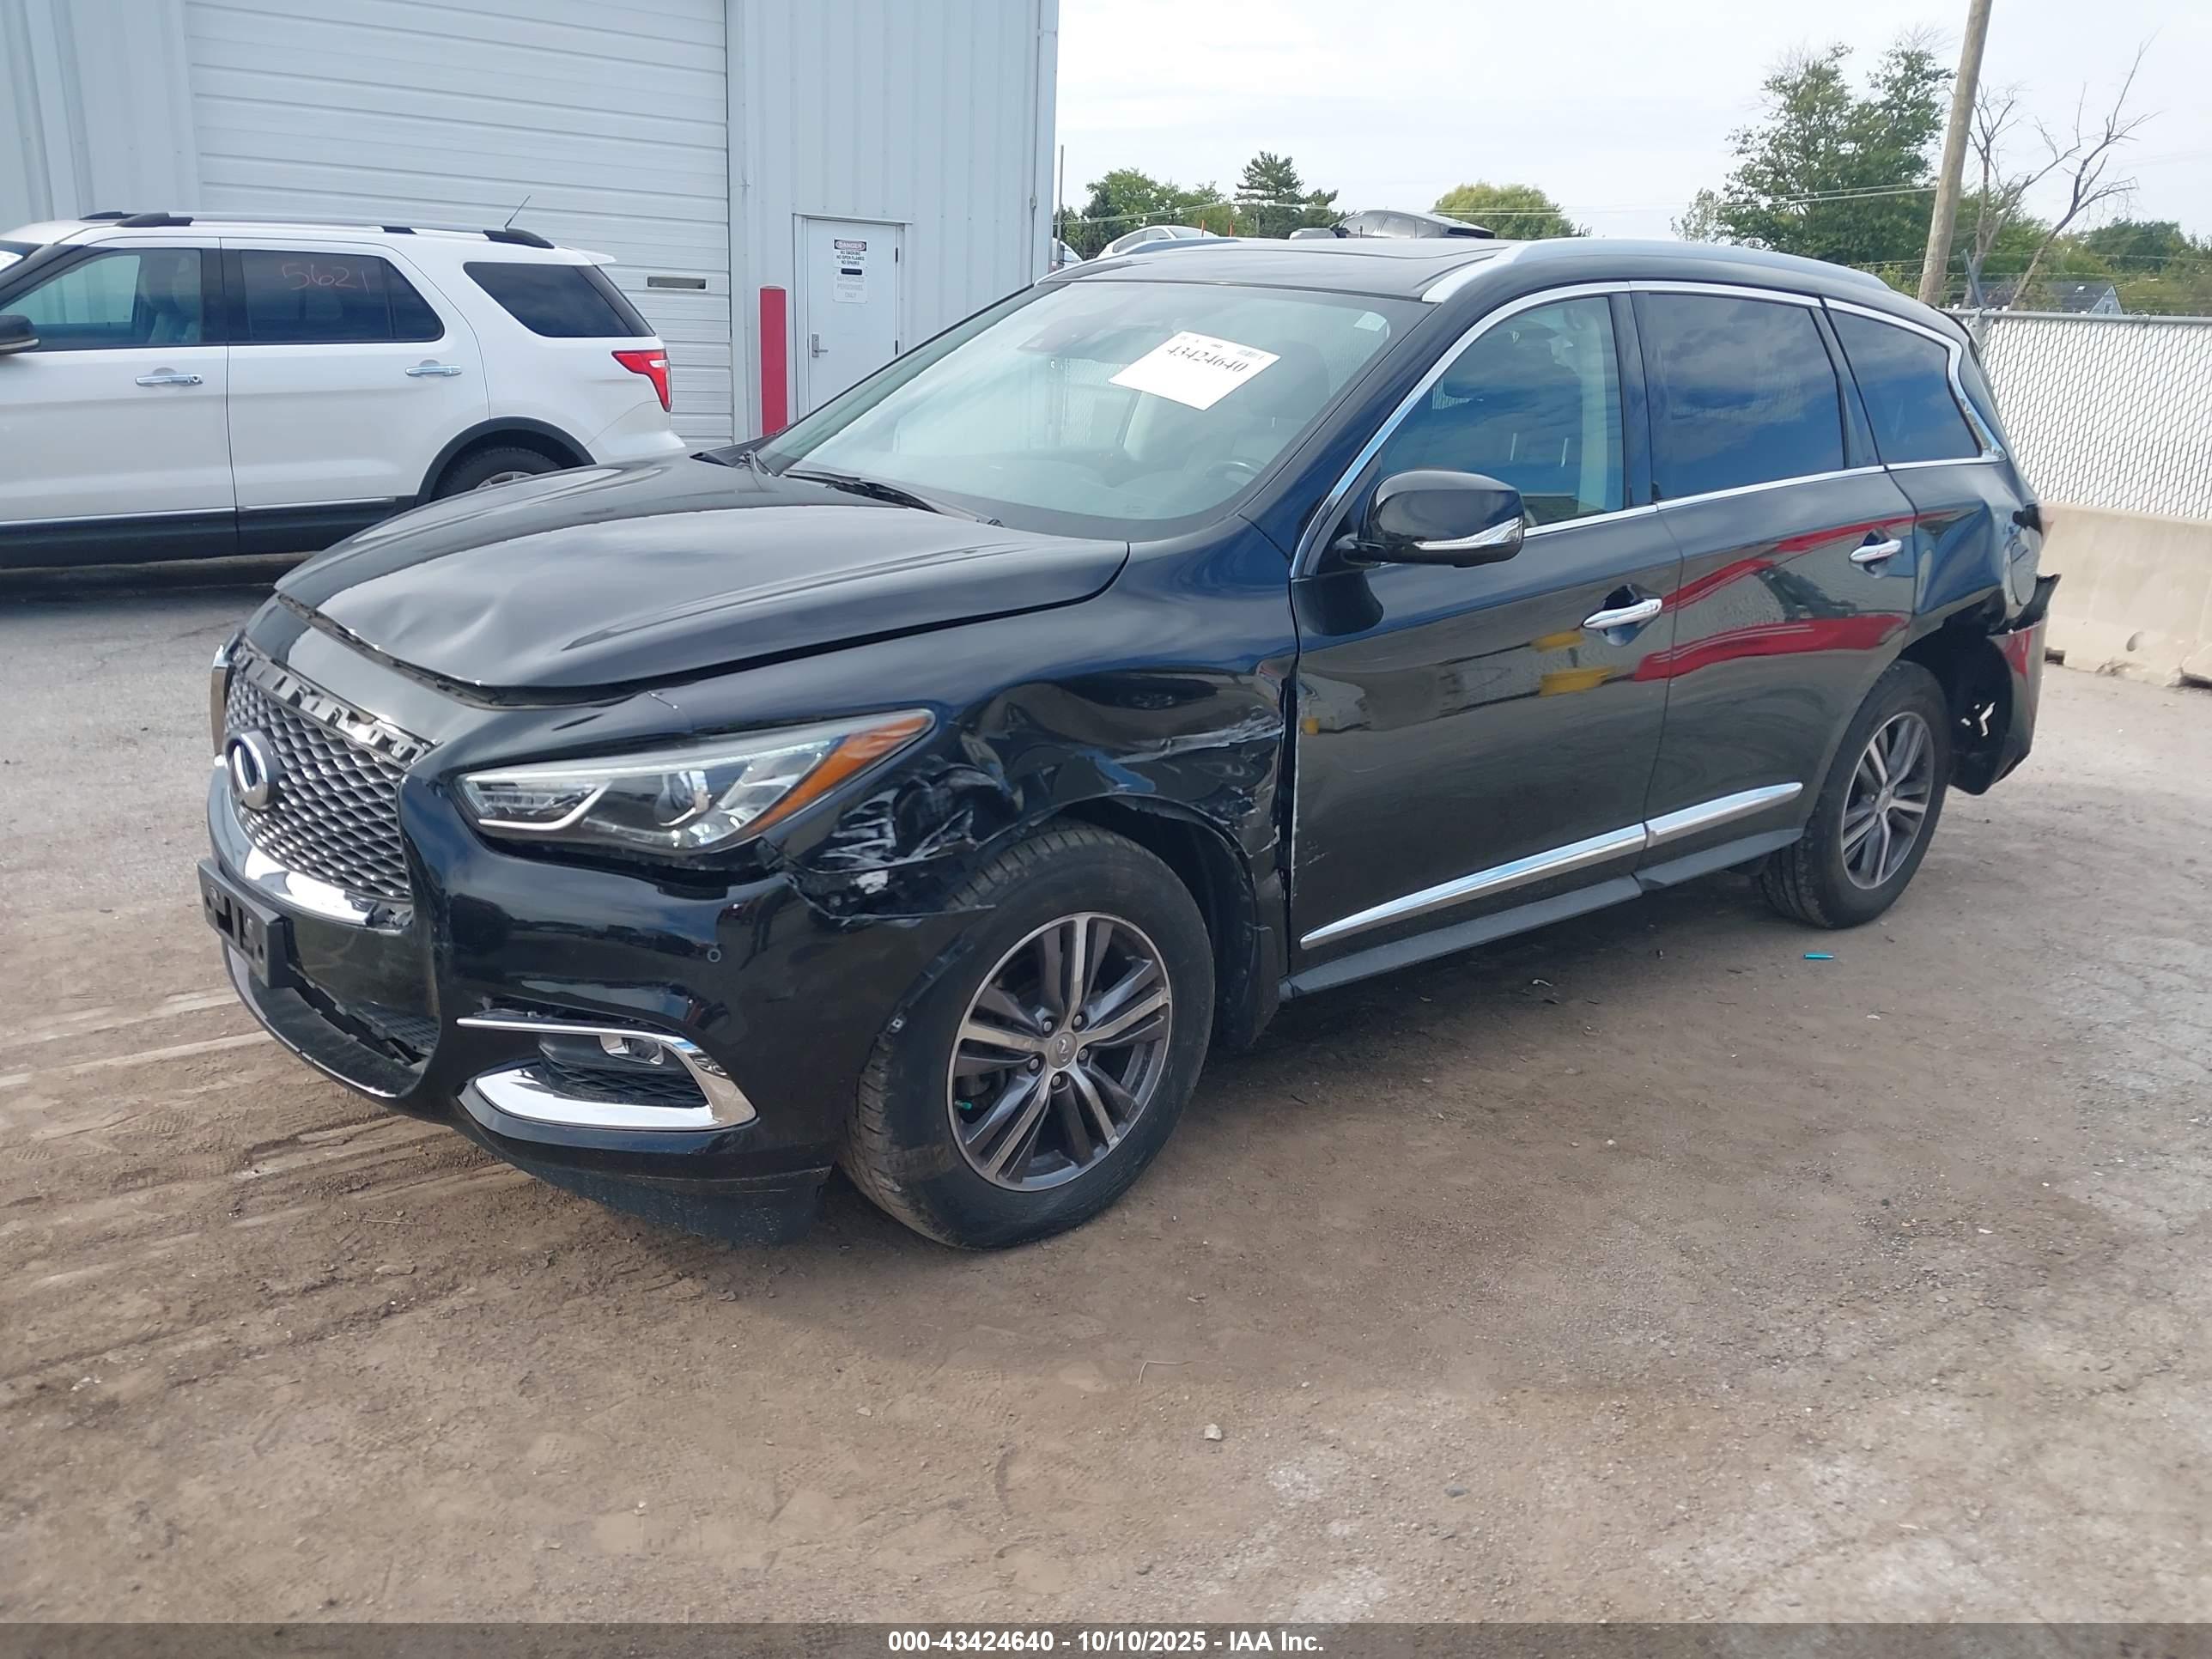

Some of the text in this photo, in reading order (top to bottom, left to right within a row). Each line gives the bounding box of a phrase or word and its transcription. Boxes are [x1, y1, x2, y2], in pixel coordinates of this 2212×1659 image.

[839, 241, 862, 250] DANGER
[282, 263, 370, 296] 5621
[1167, 345, 1249, 372] 43424640
